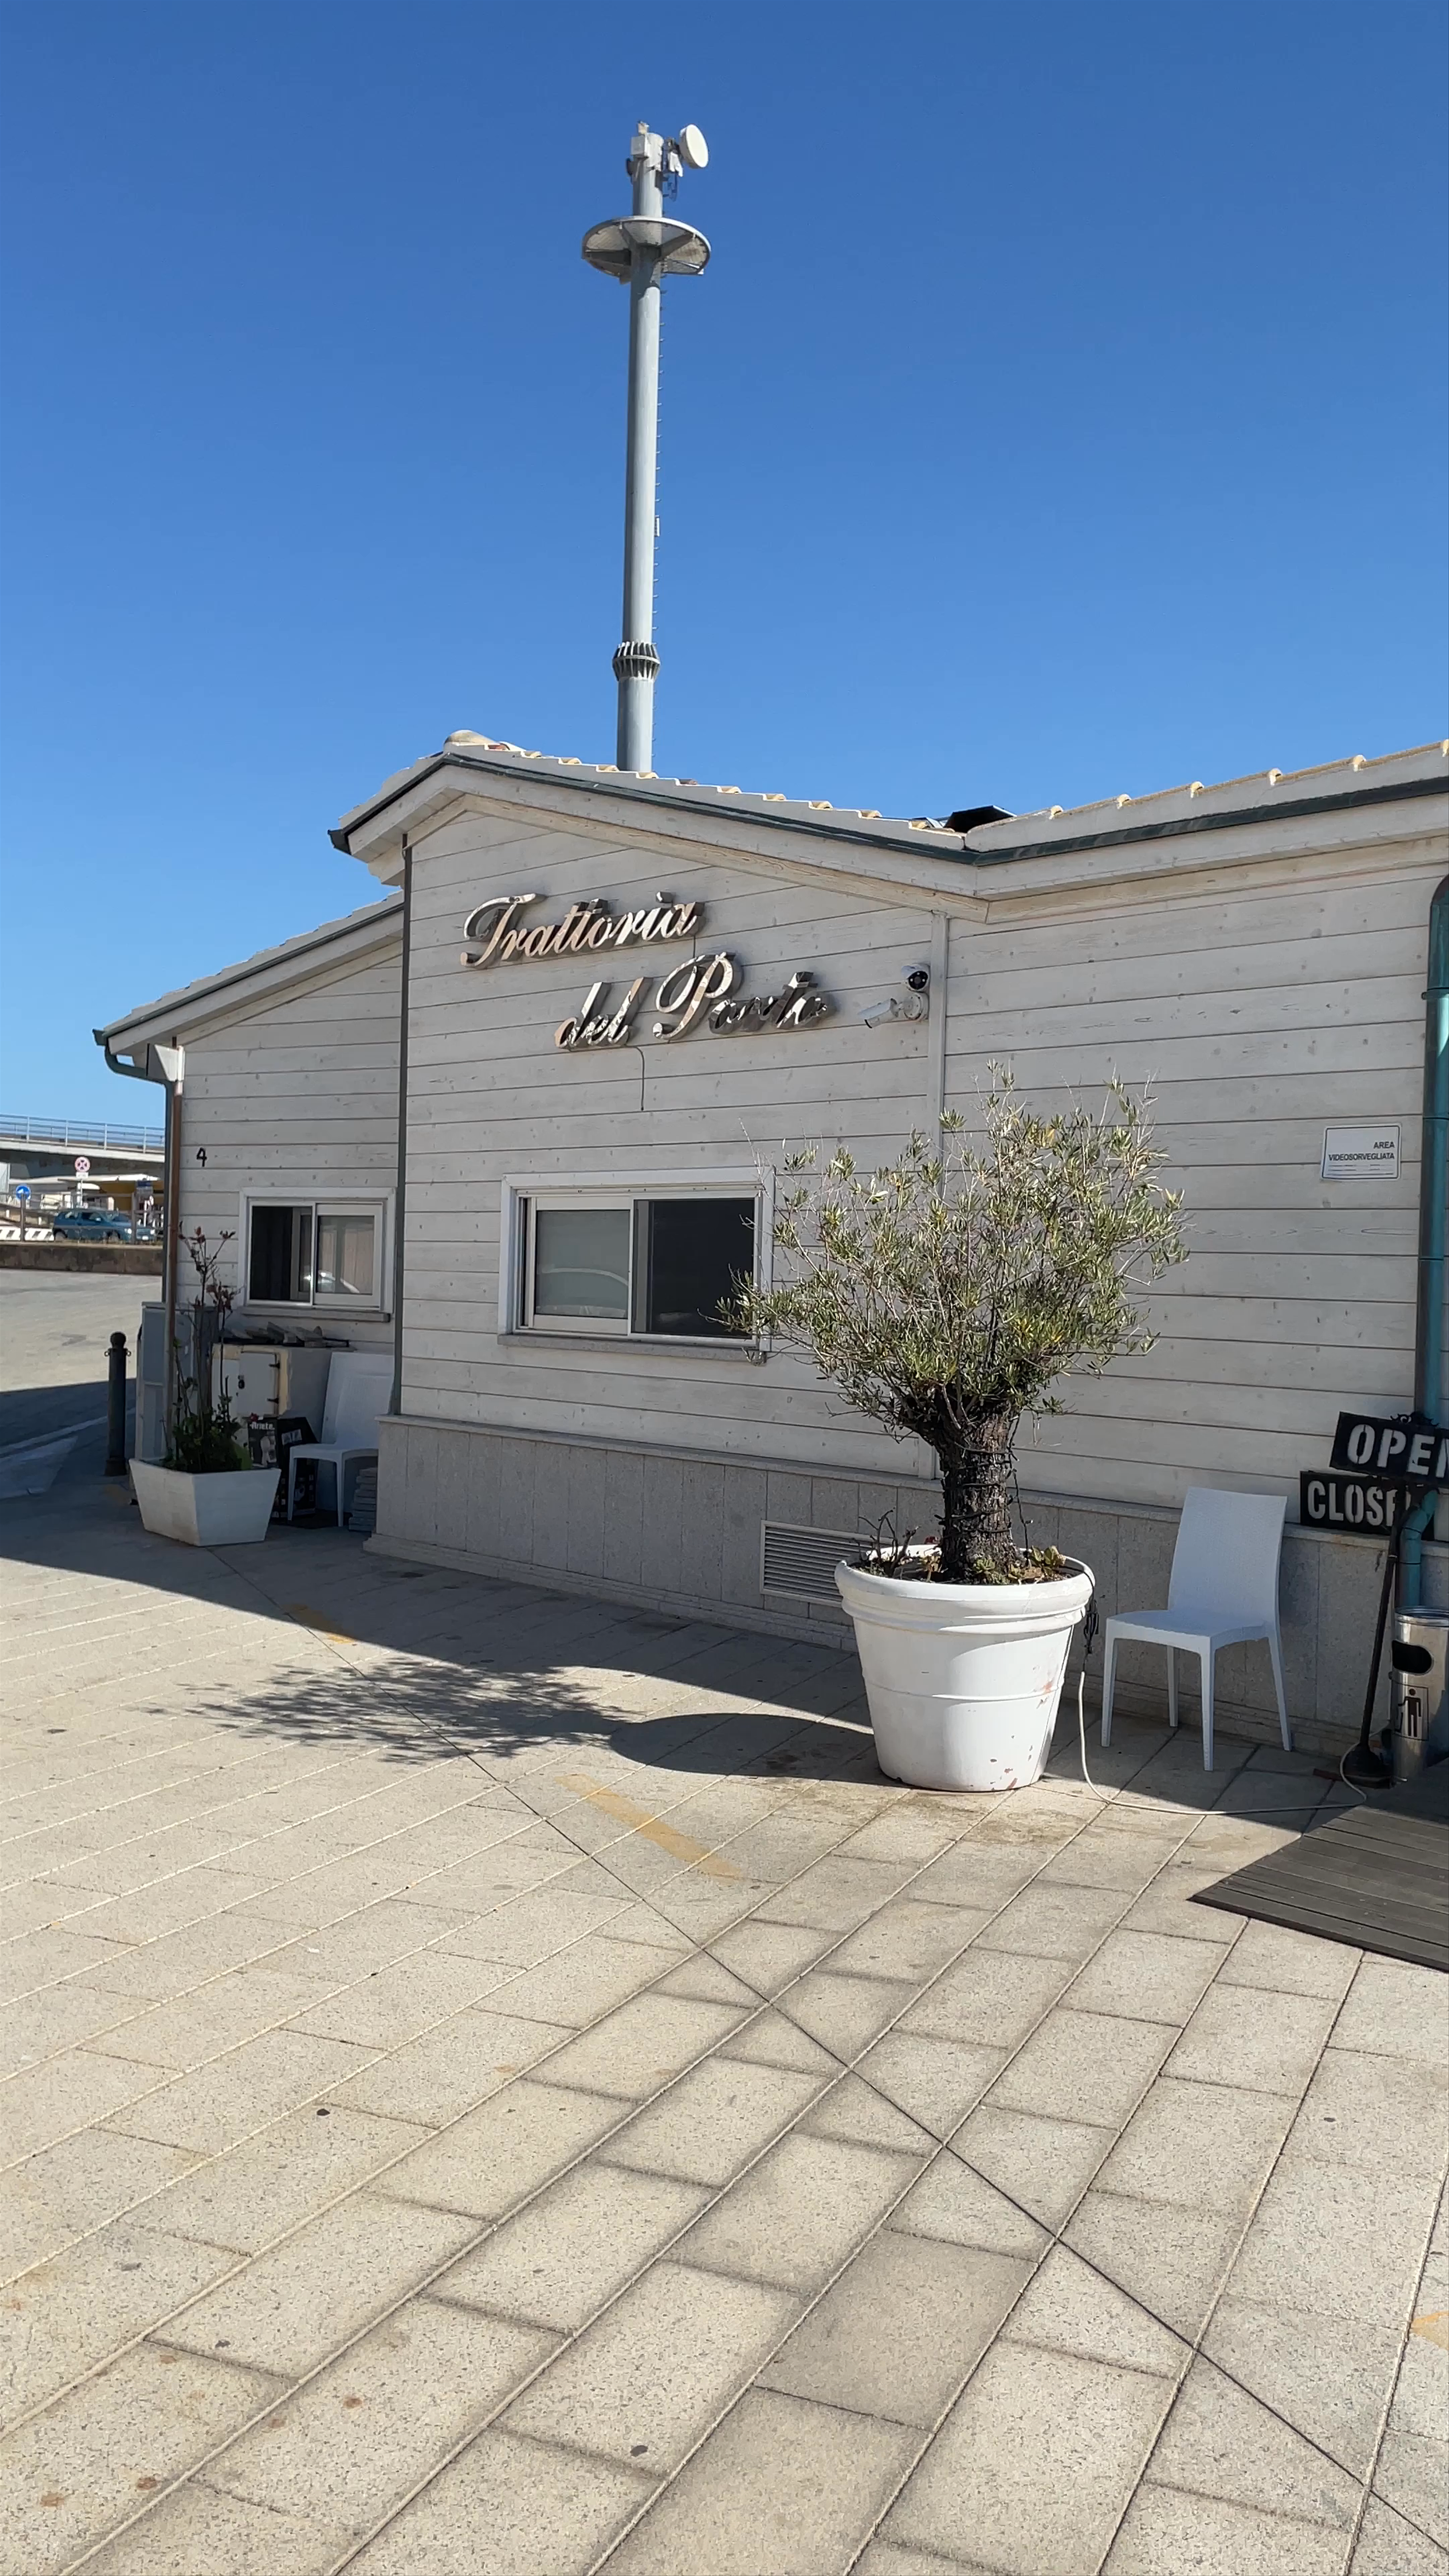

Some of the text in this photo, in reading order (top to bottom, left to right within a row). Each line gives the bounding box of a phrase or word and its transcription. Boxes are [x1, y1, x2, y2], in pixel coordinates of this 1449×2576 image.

[460, 891, 703, 969] Trattoria
[555, 952, 832, 1049] del Porto
[197, 1147, 207, 1167] 4
[1329, 1153, 1395, 1161] VIDEOSORVEGLIATA
[1307, 1480, 1411, 1526] CLOSE
